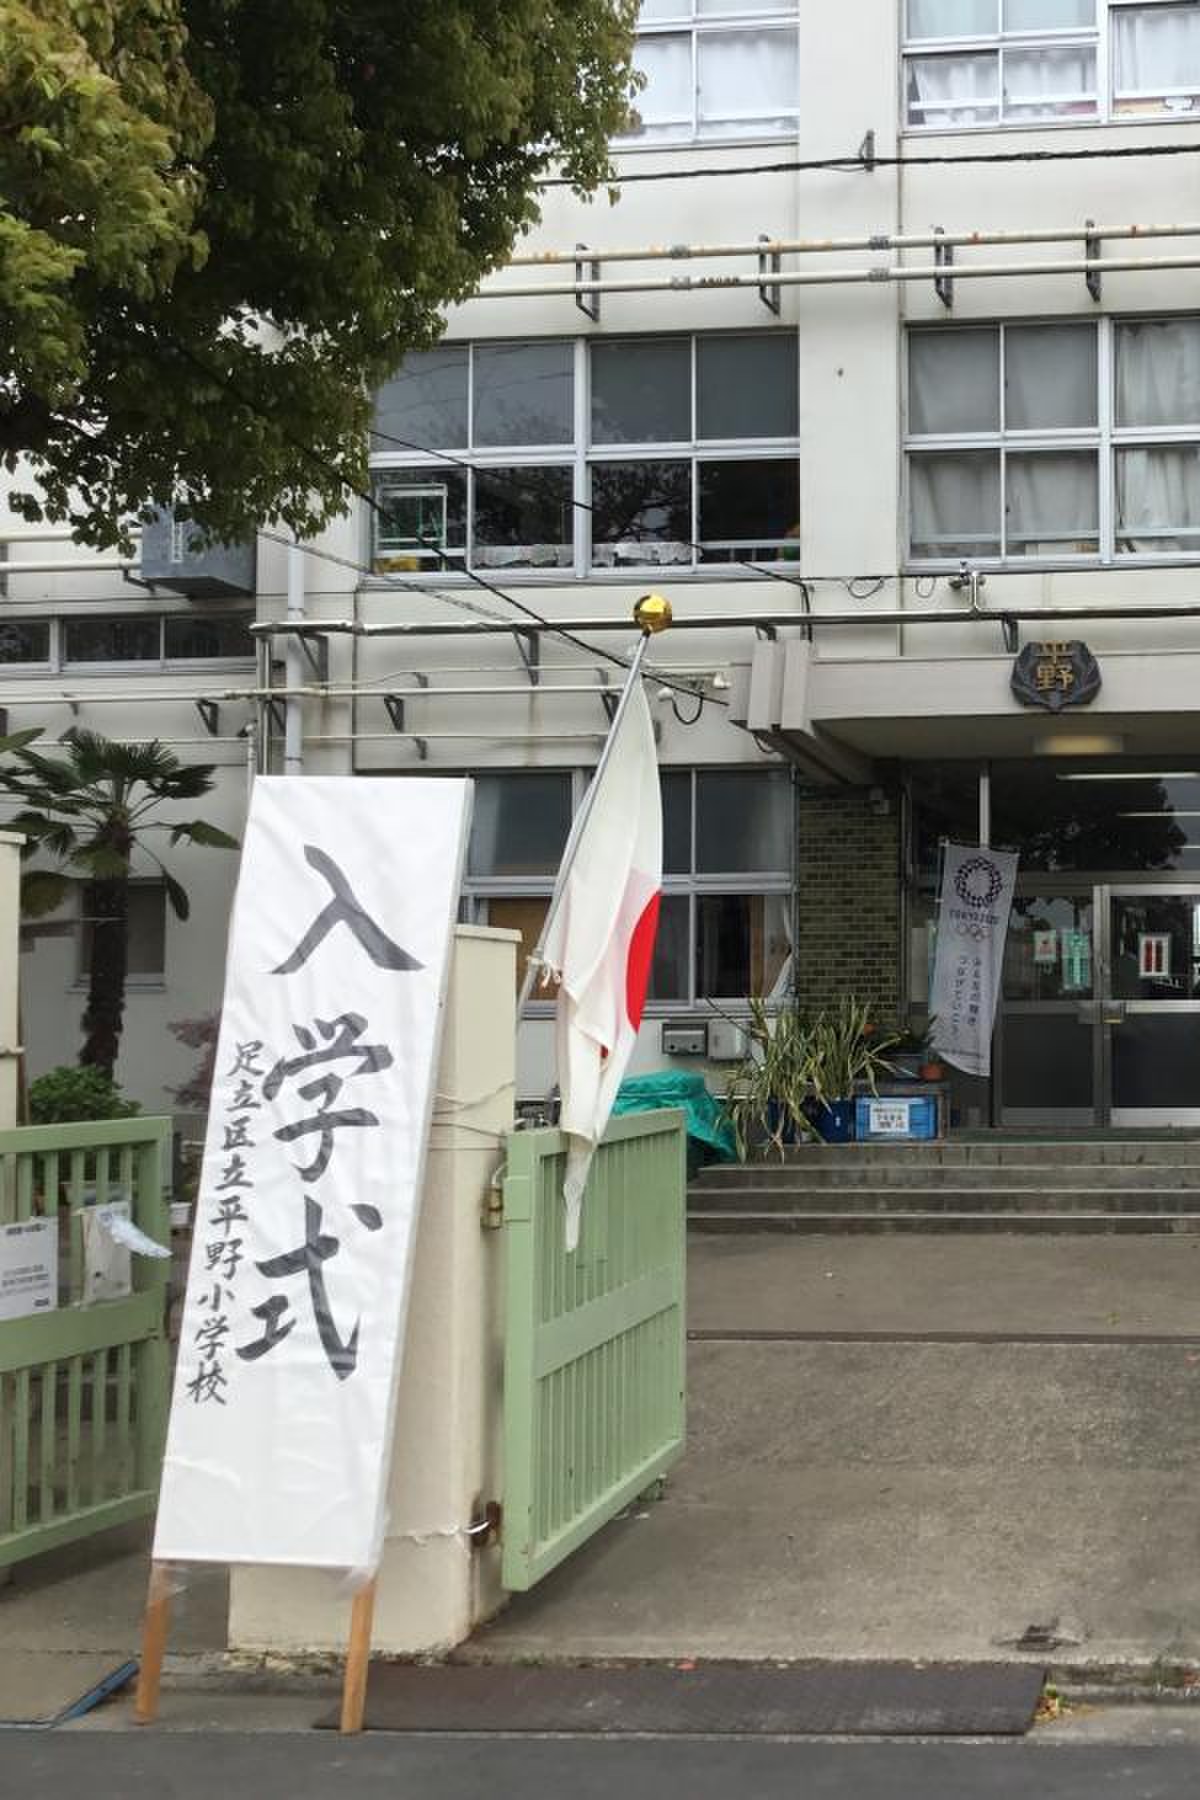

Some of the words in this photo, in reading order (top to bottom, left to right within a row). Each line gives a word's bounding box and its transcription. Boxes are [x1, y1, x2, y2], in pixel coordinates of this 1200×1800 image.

[186, 1040, 264, 1405] 足立区立平野小学校
[235, 844, 427, 1381] 入学式
